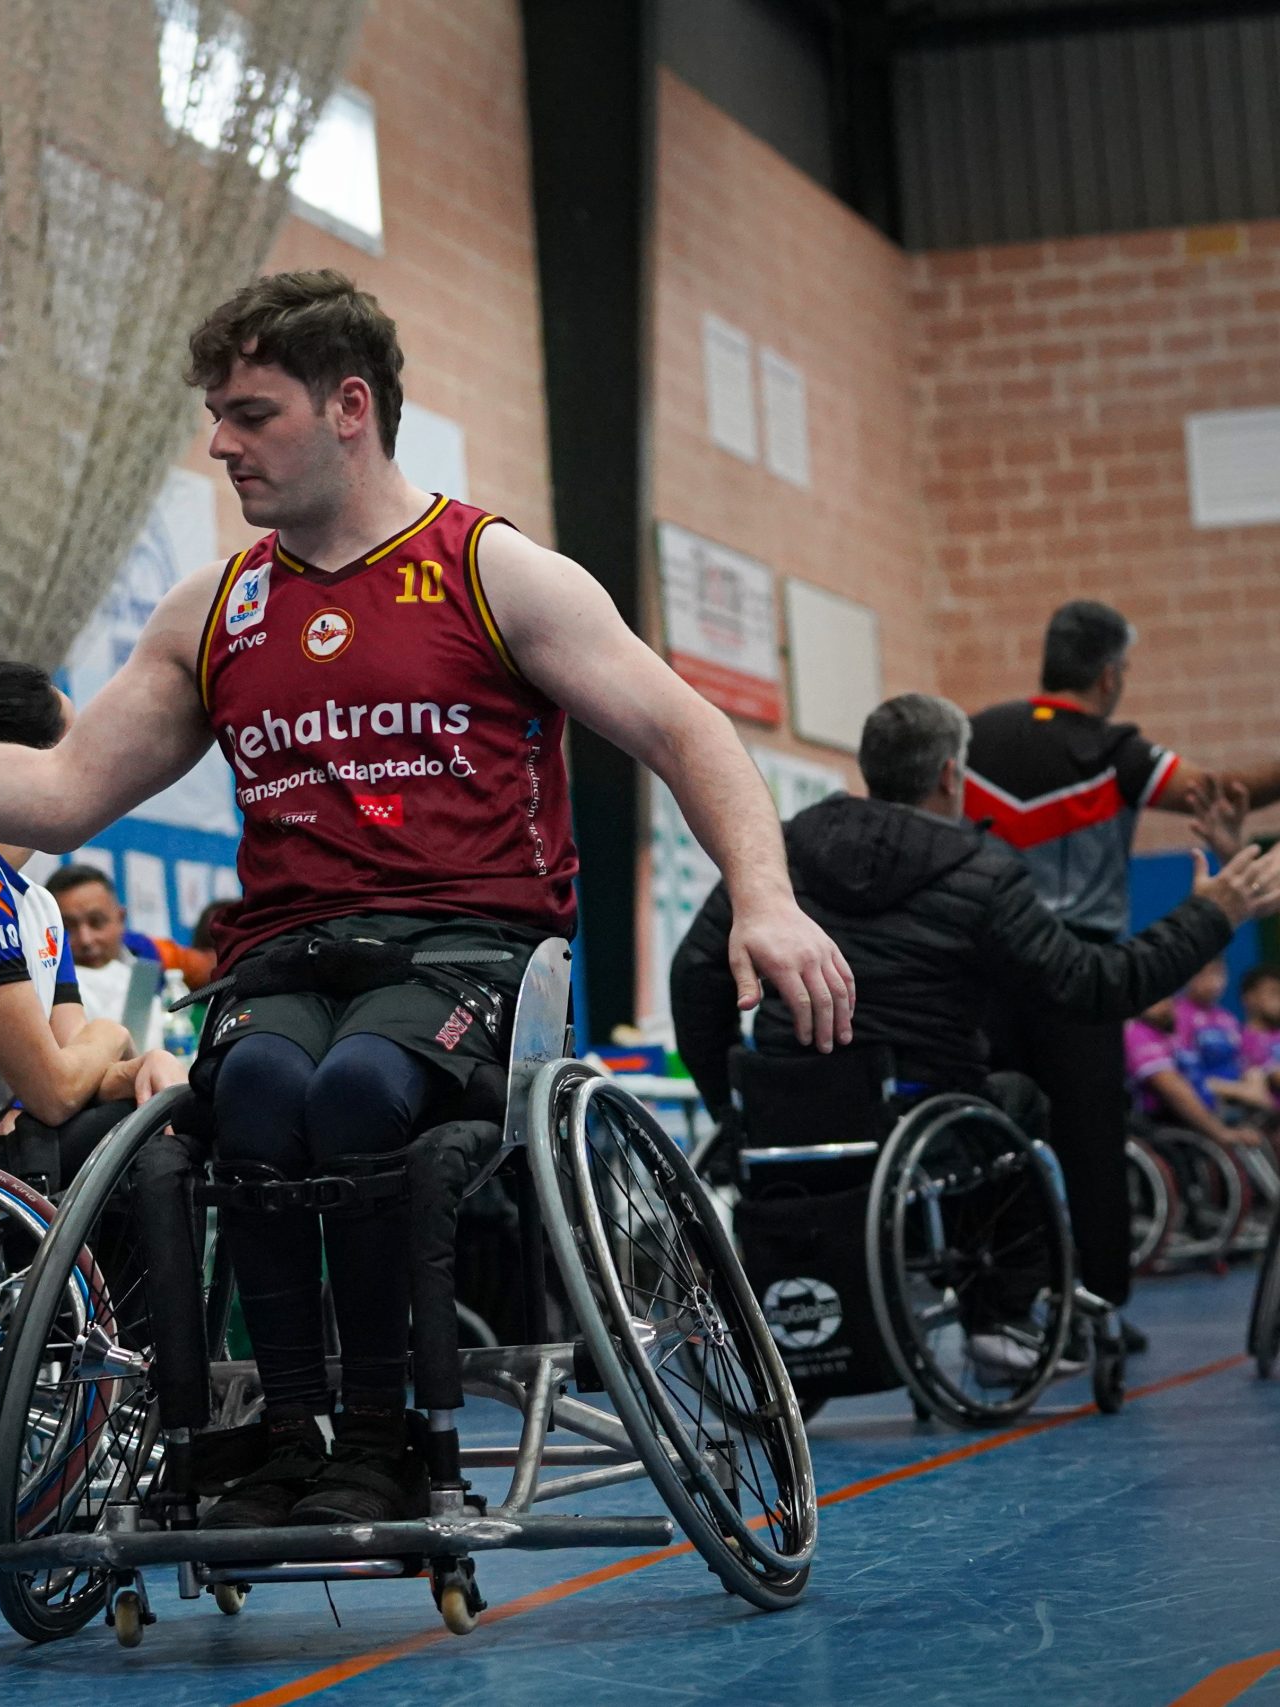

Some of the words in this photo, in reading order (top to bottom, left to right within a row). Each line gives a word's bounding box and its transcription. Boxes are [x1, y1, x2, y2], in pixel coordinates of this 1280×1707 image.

[395, 560, 446, 603] 10
[228, 631, 267, 654] vive
[327, 755, 444, 784] Adaptado
